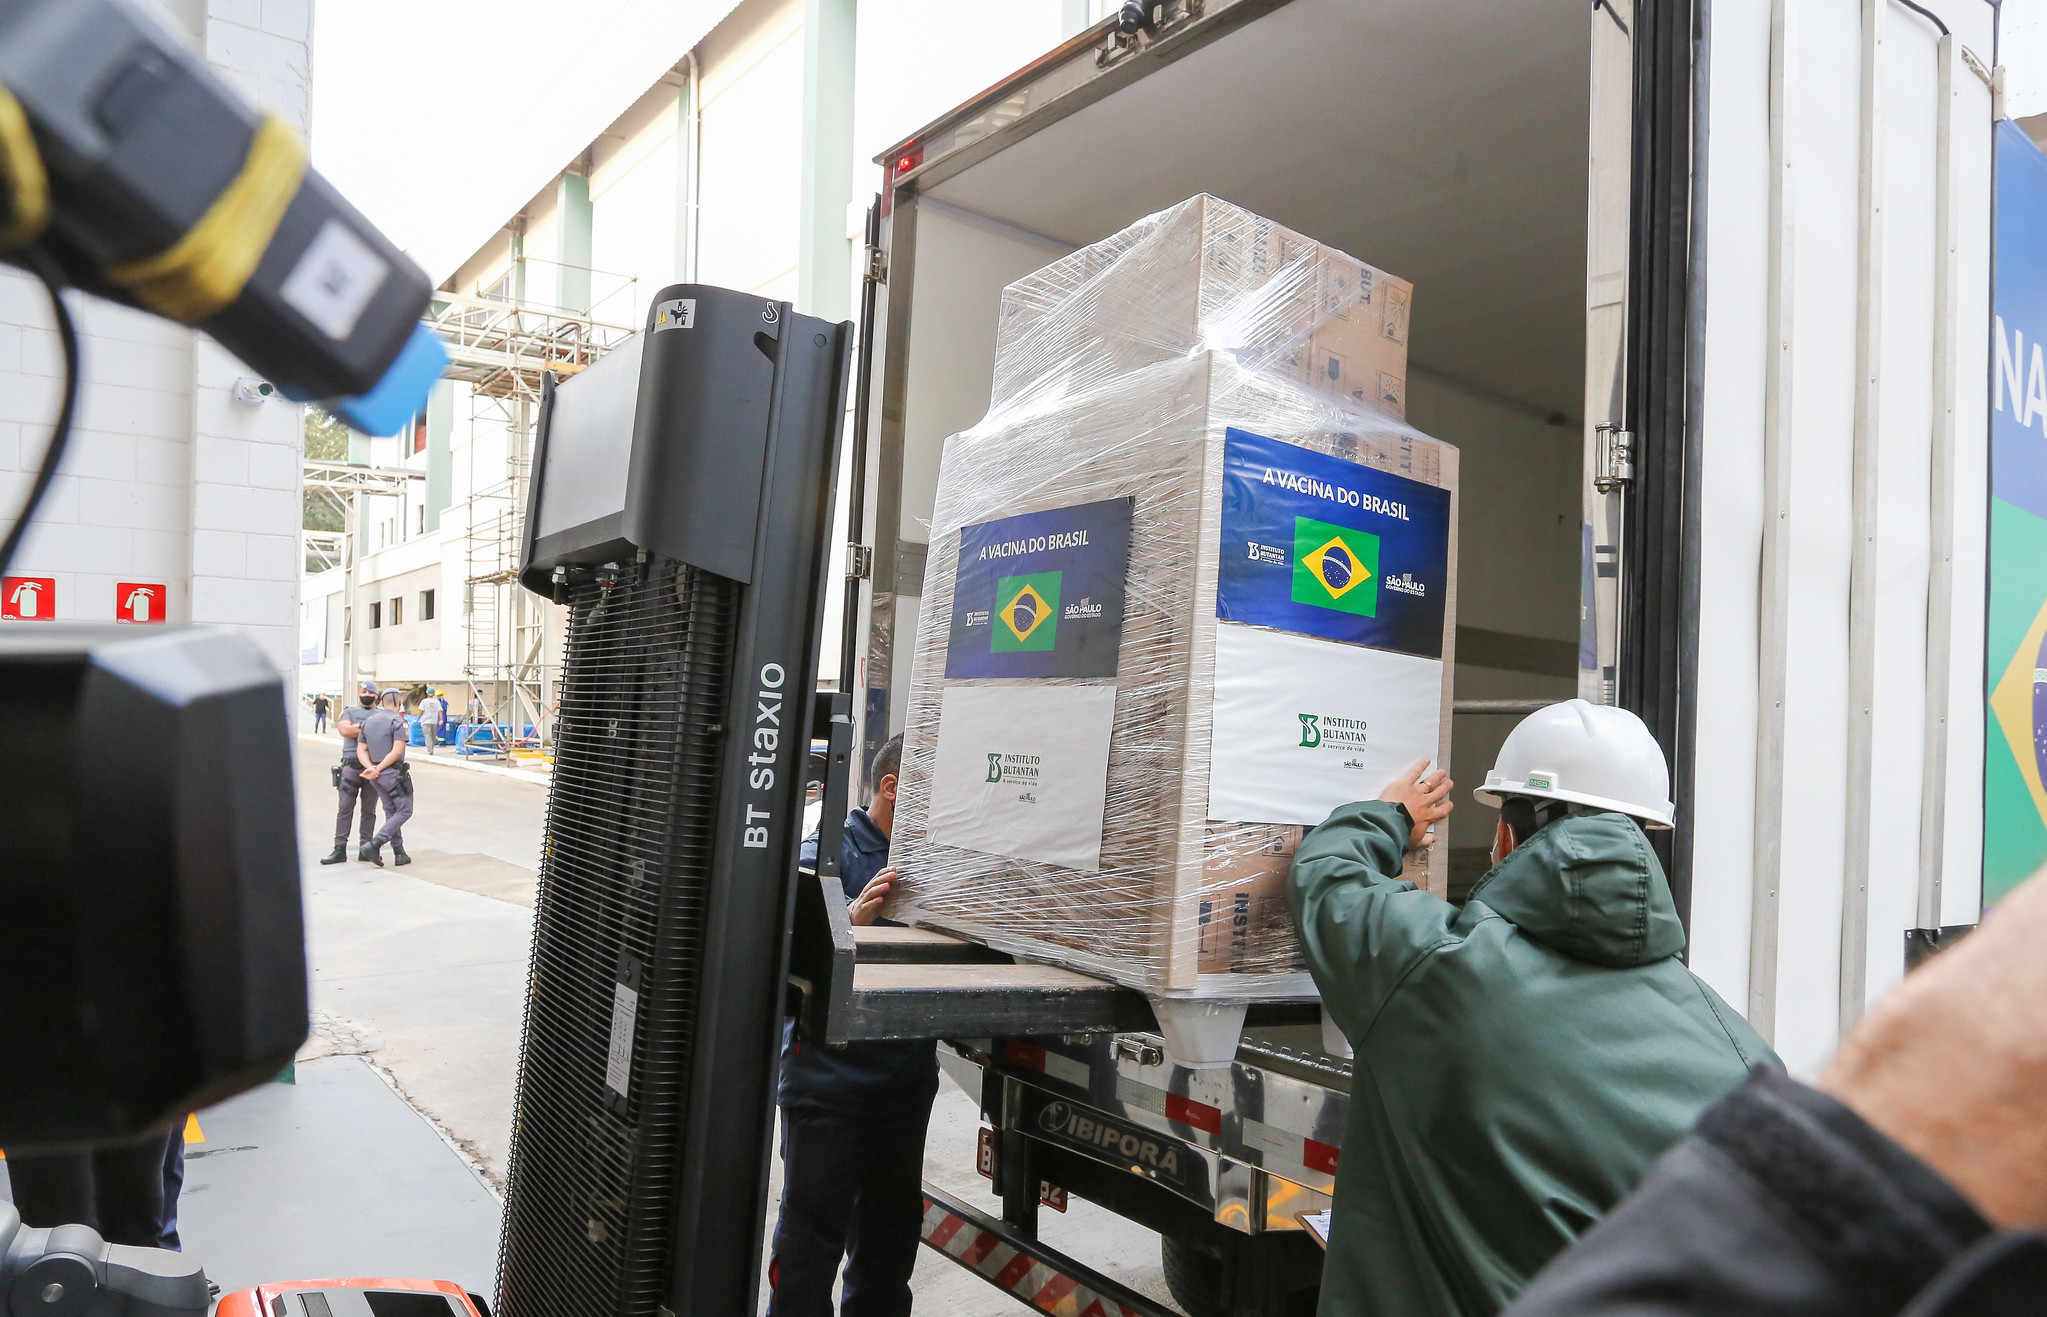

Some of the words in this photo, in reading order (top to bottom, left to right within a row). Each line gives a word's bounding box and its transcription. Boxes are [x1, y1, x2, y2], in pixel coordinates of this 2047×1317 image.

[1262, 467, 1275, 486] A
[1276, 470, 1335, 501] VACINA
[1337, 487, 1360, 507] DO
[1362, 493, 1410, 521] BRASIL
[979, 546, 987, 561] A
[988, 539, 1027, 560] VACINA
[1028, 536, 1046, 554] DO
[1048, 529, 1090, 550] BRASIL
[1385, 574, 1401, 587] SÃO
[1402, 580, 1425, 592] PAULO
[1065, 603, 1079, 615] SÃO
[1079, 603, 1102, 614] PAULO
[749, 662, 786, 792] staxio
[1323, 716, 1367, 731] INSTITUTO
[1323, 728, 1367, 742] BUTANTAN
[1004, 754, 1040, 765] INSTITUTO
[1003, 766, 1039, 777] BUTANTAN
[1529, 779, 1548, 788] MSA
[743, 803, 771, 849] BT
[1067, 1114, 1178, 1175] IBIPORÃ
